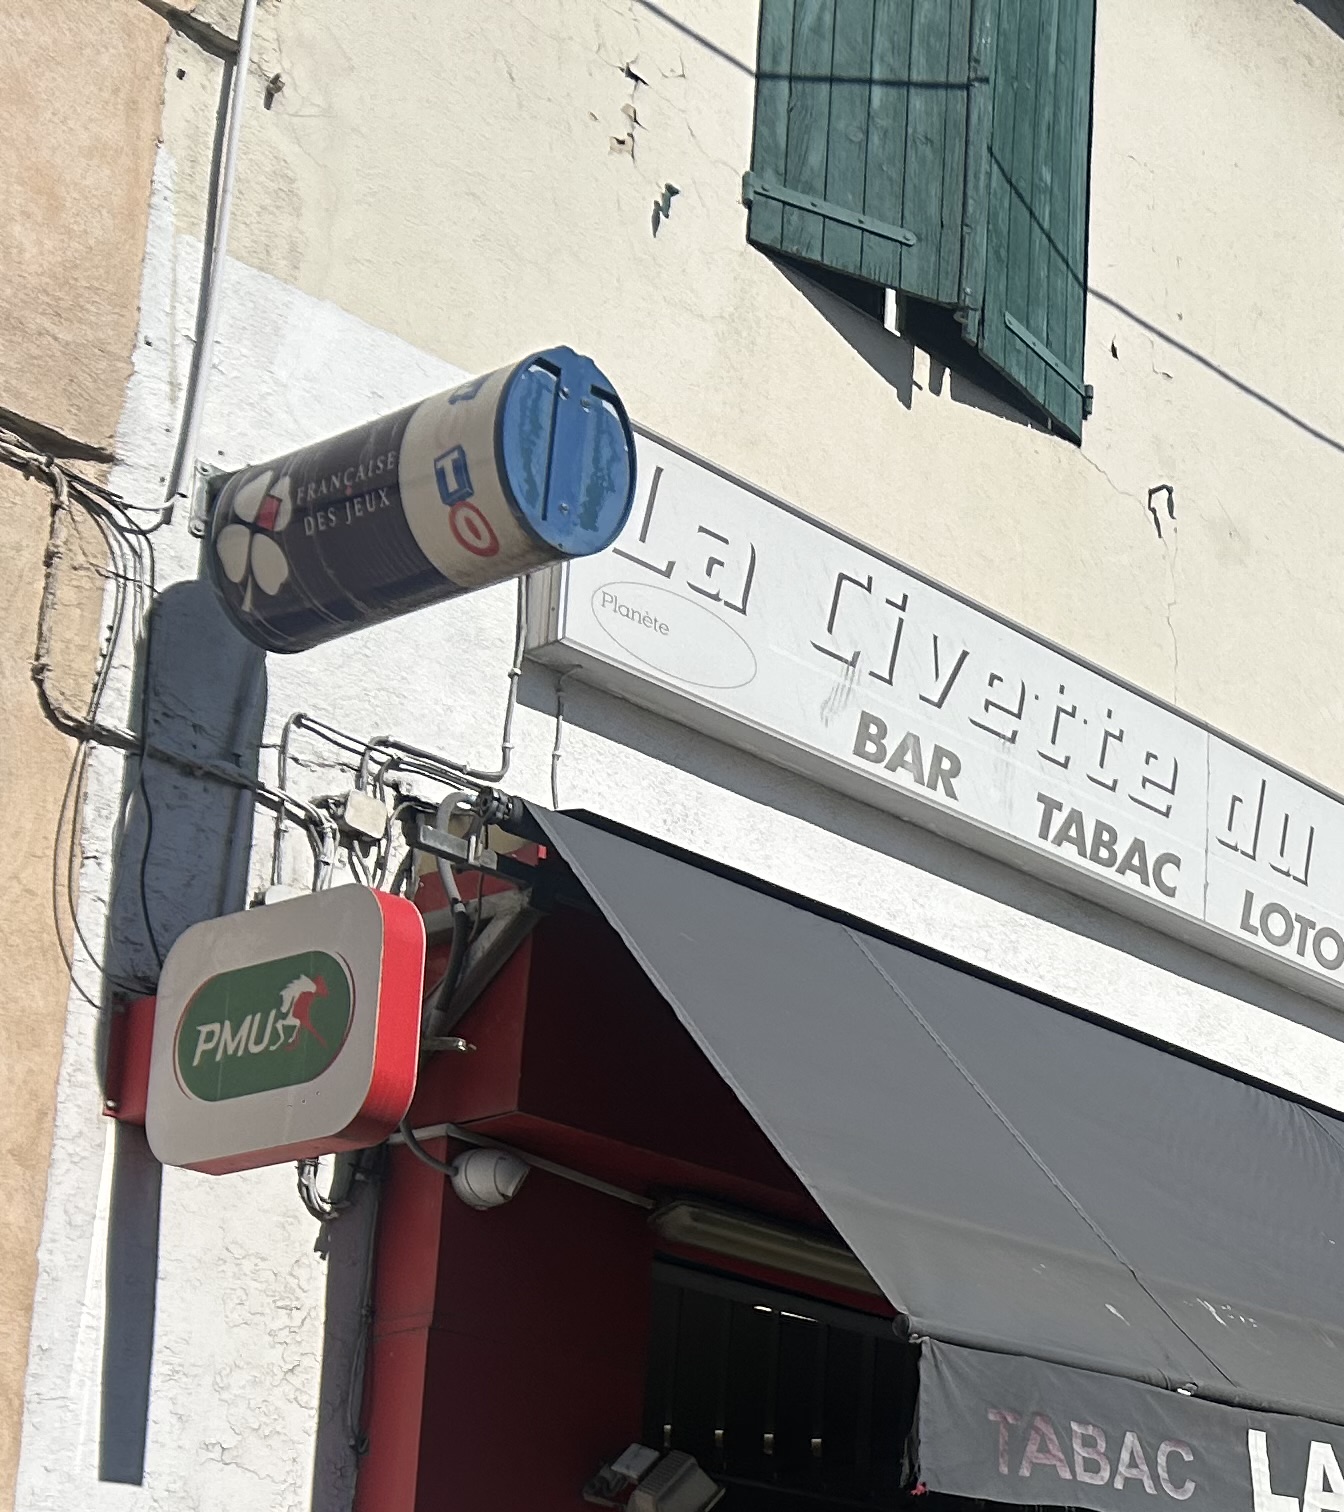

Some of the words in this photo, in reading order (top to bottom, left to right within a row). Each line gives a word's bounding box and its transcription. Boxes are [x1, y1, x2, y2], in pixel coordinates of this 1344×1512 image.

[296, 450, 399, 504] FRANÇAISE
[303, 511, 337, 537] DES
[344, 486, 391, 525] JEUX
[601, 590, 670, 636] Planète
[606, 460, 757, 616] La
[808, 568, 1180, 818] Civette
[1215, 778, 1316, 886] du
[853, 711, 963, 800] BAR
[1037, 793, 1182, 899] TABAC
[193, 1007, 275, 1067] PMU
[987, 1407, 1197, 1501] TABAC
